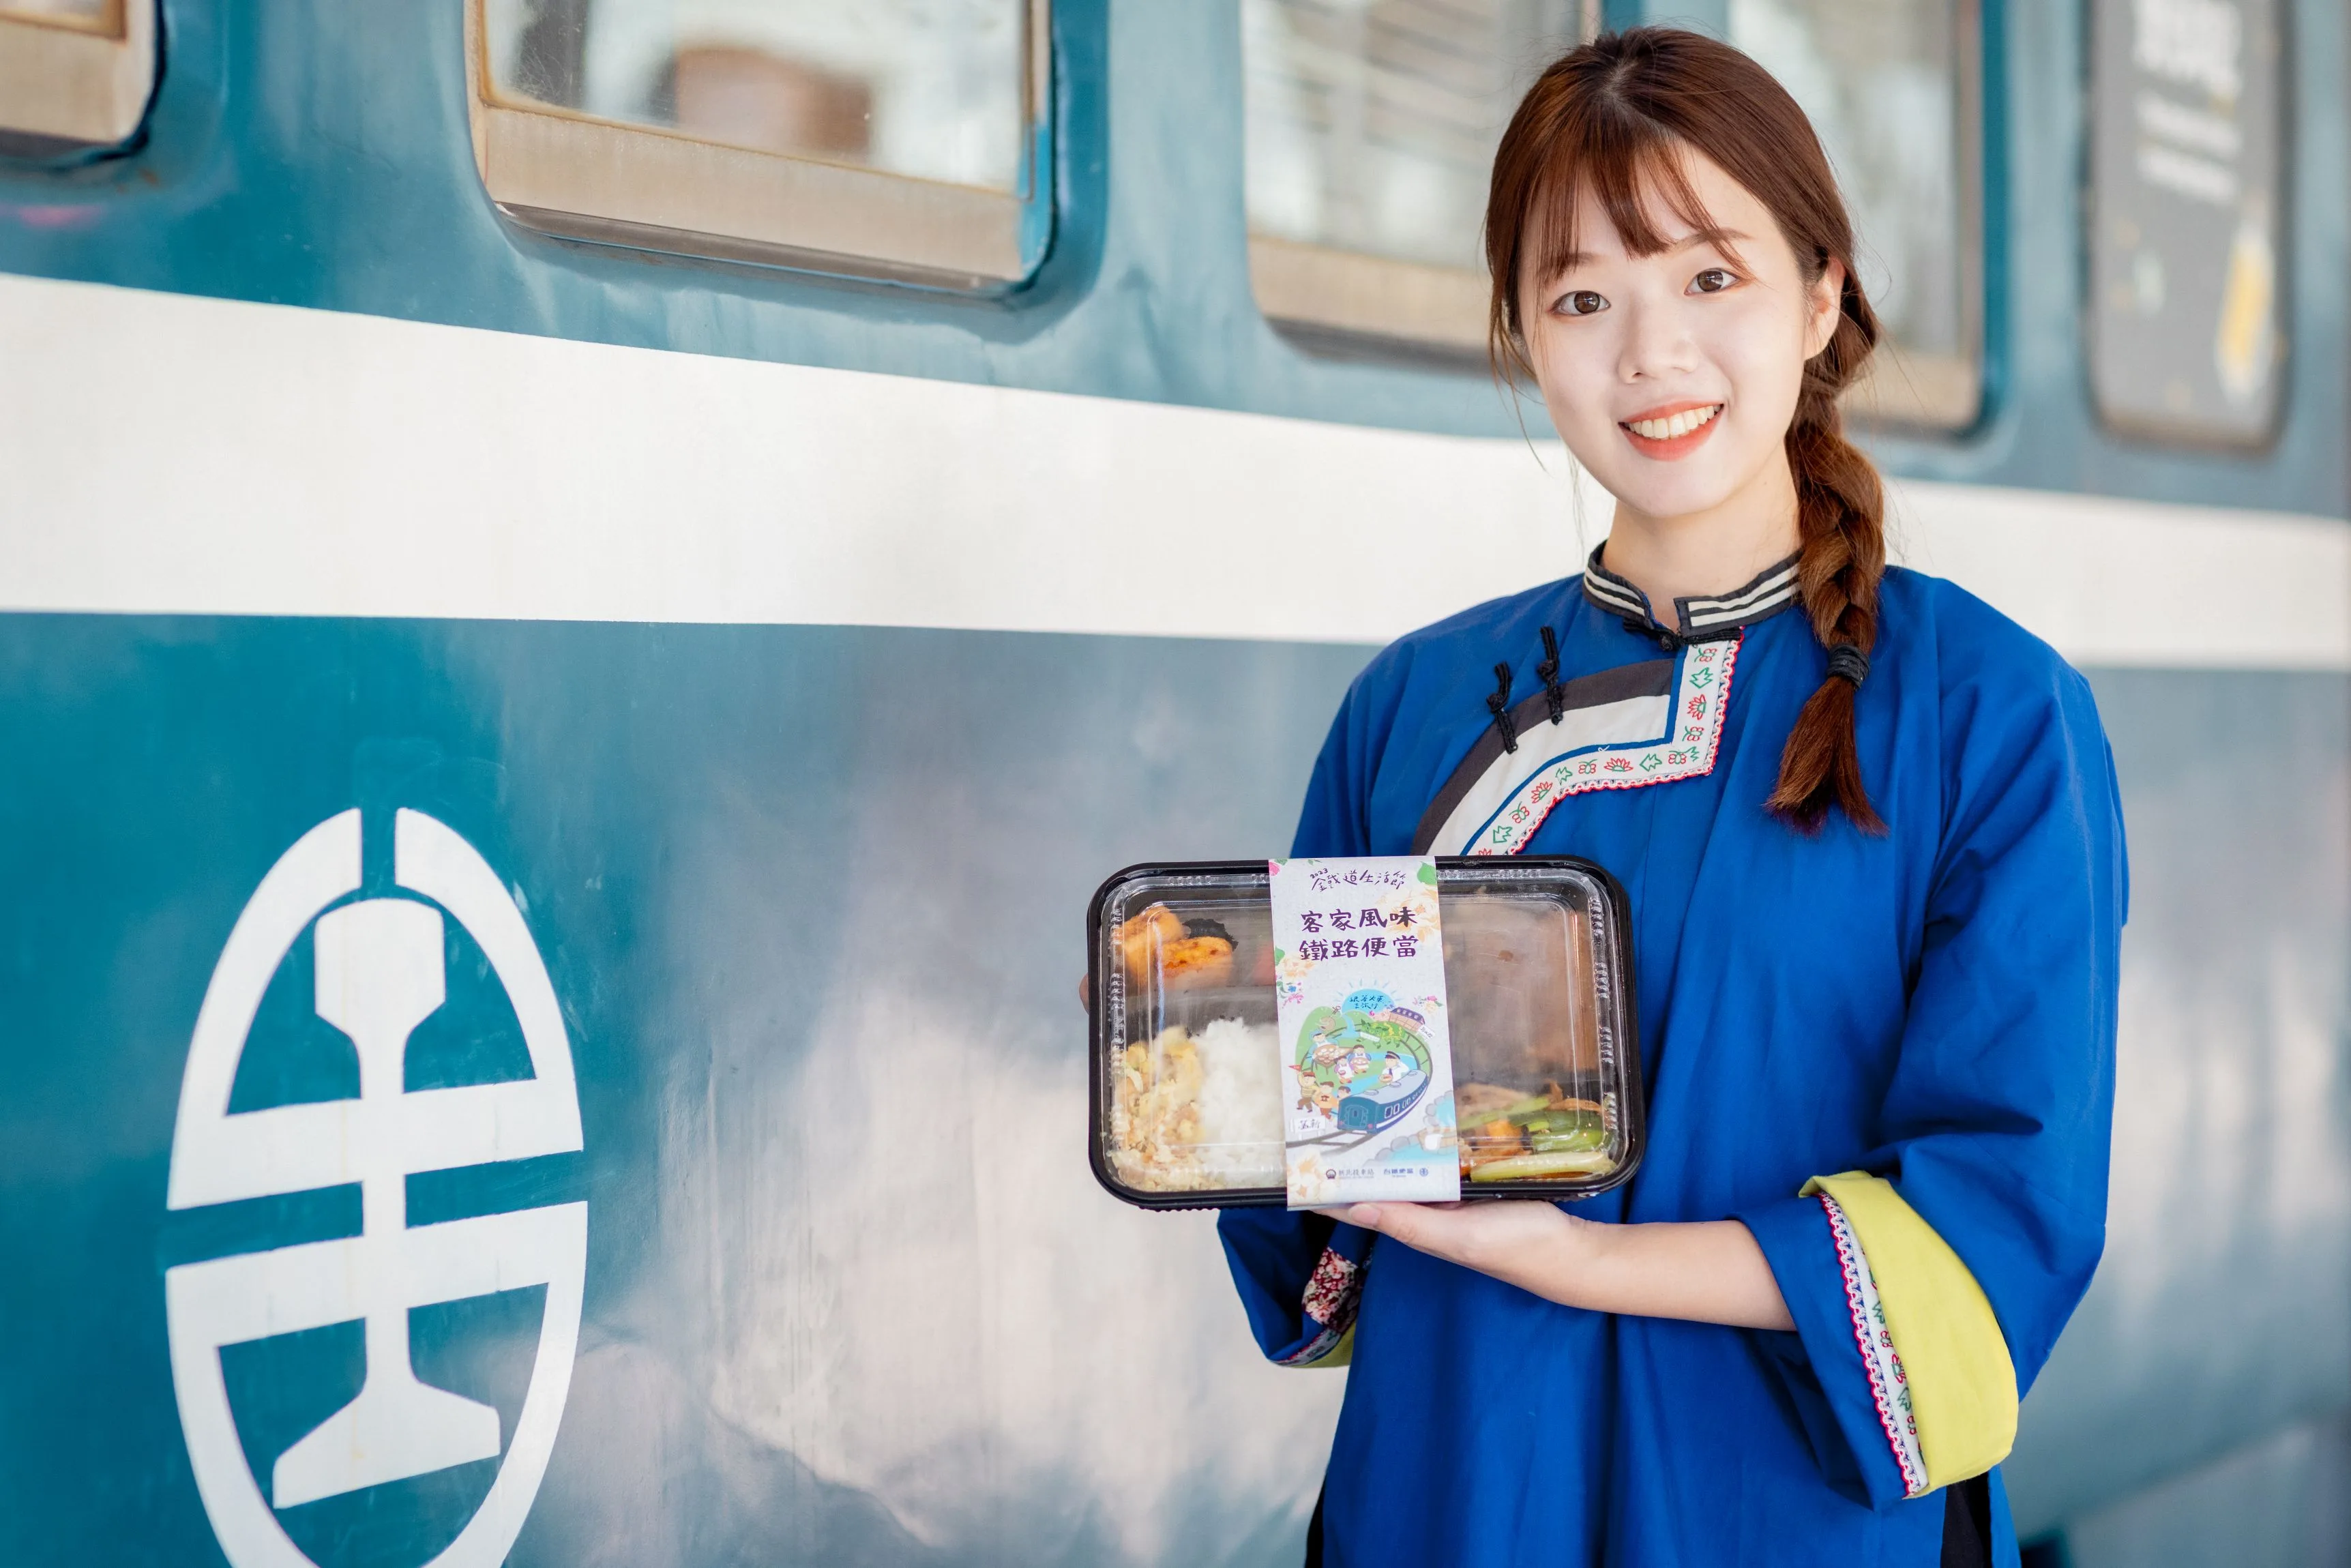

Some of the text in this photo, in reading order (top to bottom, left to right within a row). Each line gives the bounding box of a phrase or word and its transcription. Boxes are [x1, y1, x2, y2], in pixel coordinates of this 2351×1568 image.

[1310, 868, 1329, 879] 2023
[1301, 906, 1417, 933] 客家風味
[1299, 935, 1419, 961] 鐵路便當
